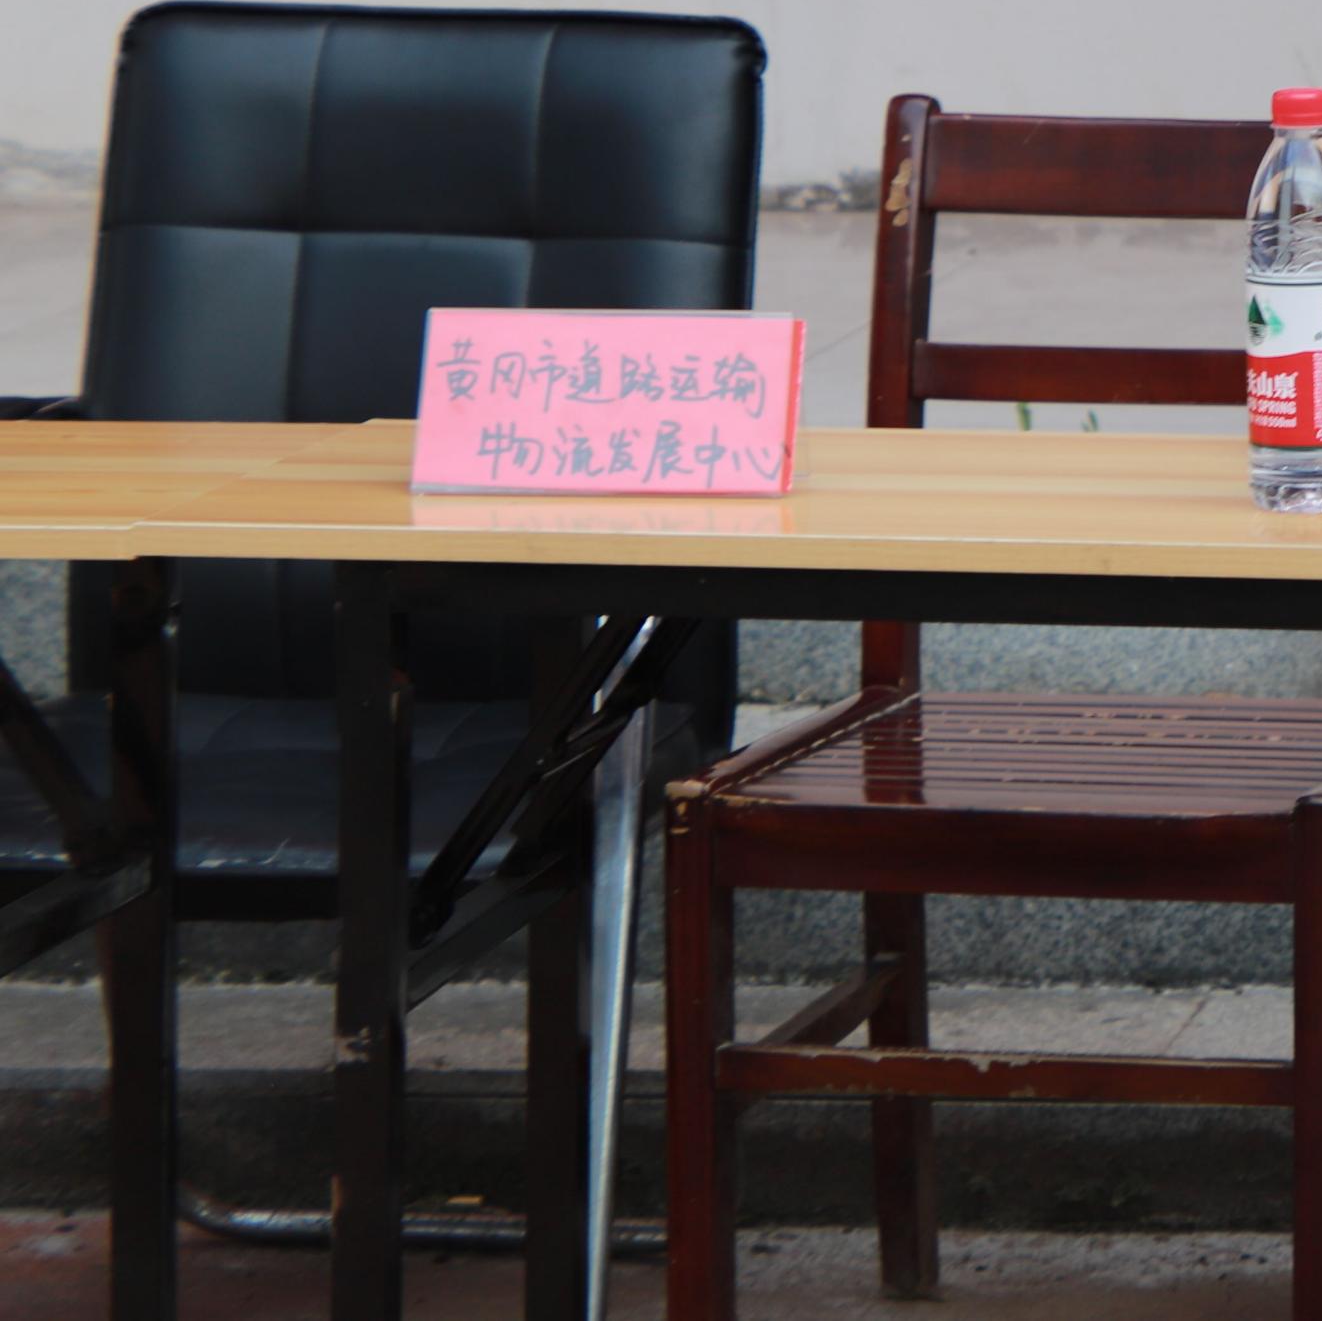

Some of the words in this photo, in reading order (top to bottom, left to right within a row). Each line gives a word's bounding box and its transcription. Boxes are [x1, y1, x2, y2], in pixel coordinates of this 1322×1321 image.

[437, 338, 765, 418] 黄冈市道路运输
[478, 421, 791, 486] 物流发展中心
